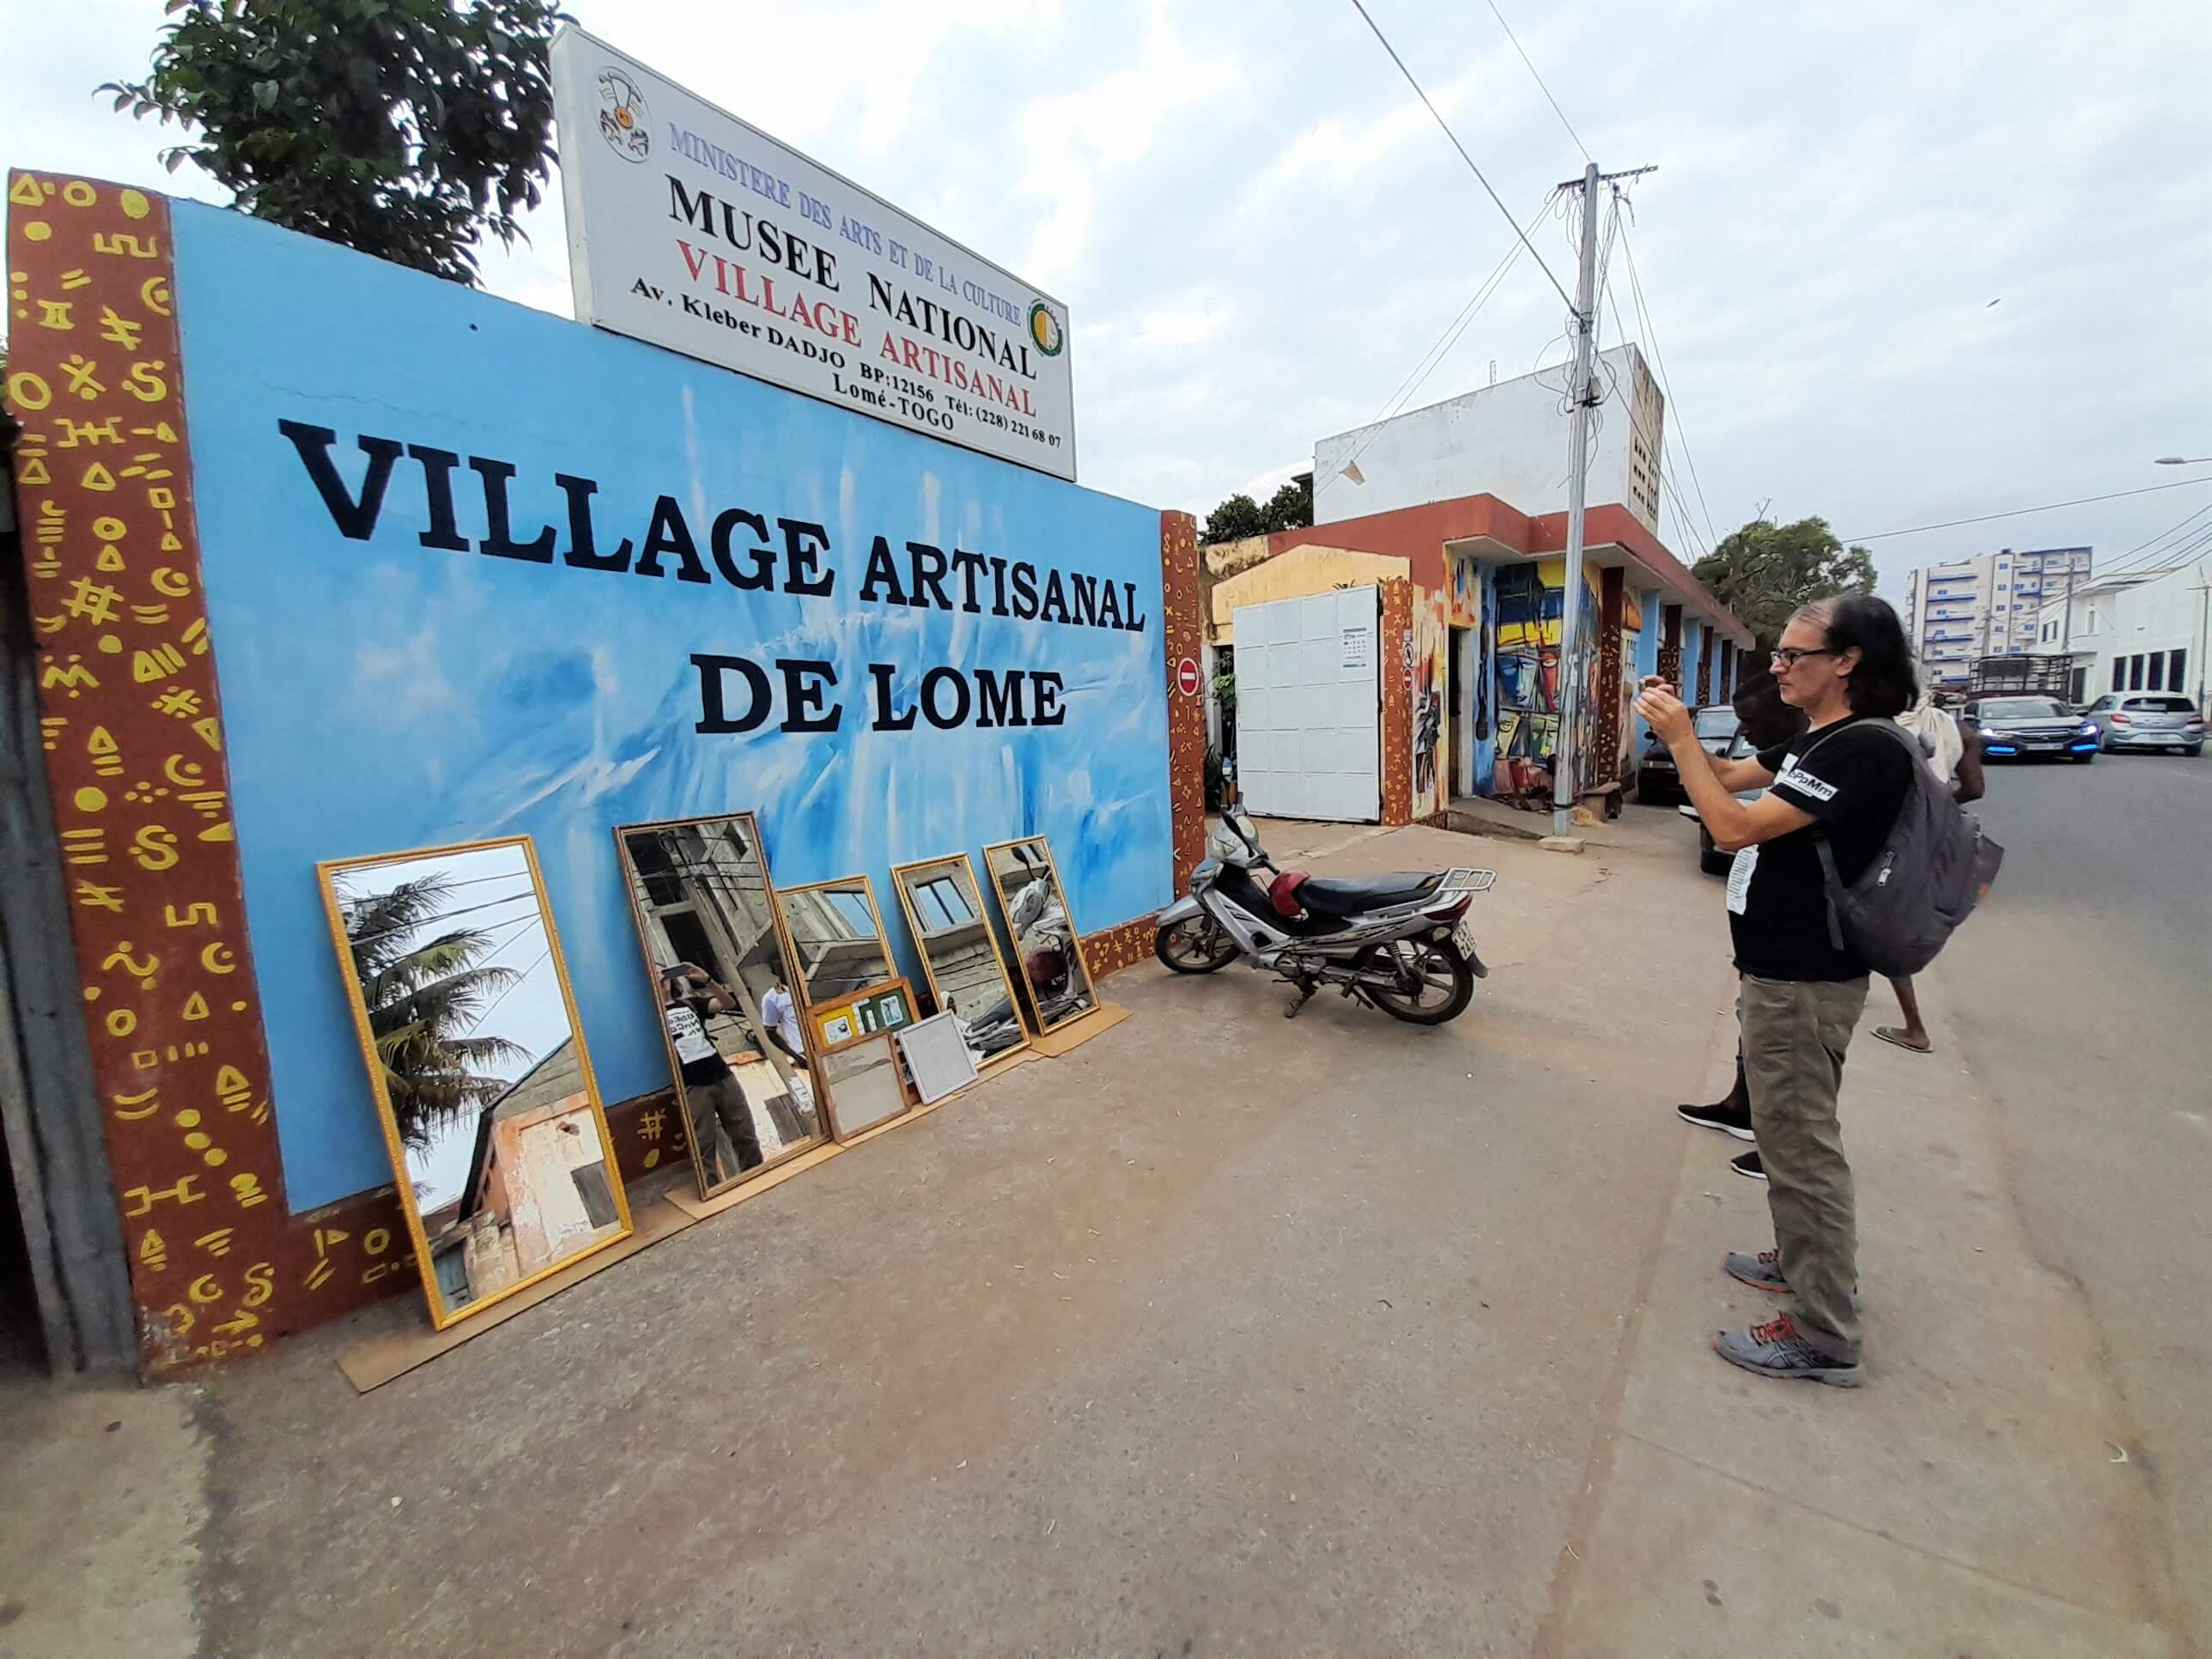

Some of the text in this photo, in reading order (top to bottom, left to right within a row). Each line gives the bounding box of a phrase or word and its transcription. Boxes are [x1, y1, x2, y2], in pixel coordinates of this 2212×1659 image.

[665, 173, 1037, 380] MUSEE NATIONAL
[668, 122, 1021, 325] MINISTERE DES ARTS ET DE LA CULTURE
[677, 239, 1037, 417] VILLAGE ARTISANAL
[681, 294, 761, 338] Kleber
[767, 326, 846, 369] DADJO
[945, 395, 973, 416] Tél:
[975, 405, 1008, 431] (228)
[1012, 421, 1029, 437] 221
[1032, 427, 1045, 443] 68
[1048, 436, 1061, 448] 07
[278, 418, 1145, 632] VILLAGE ARTISANAL
[690, 653, 1066, 734] DE LOME
